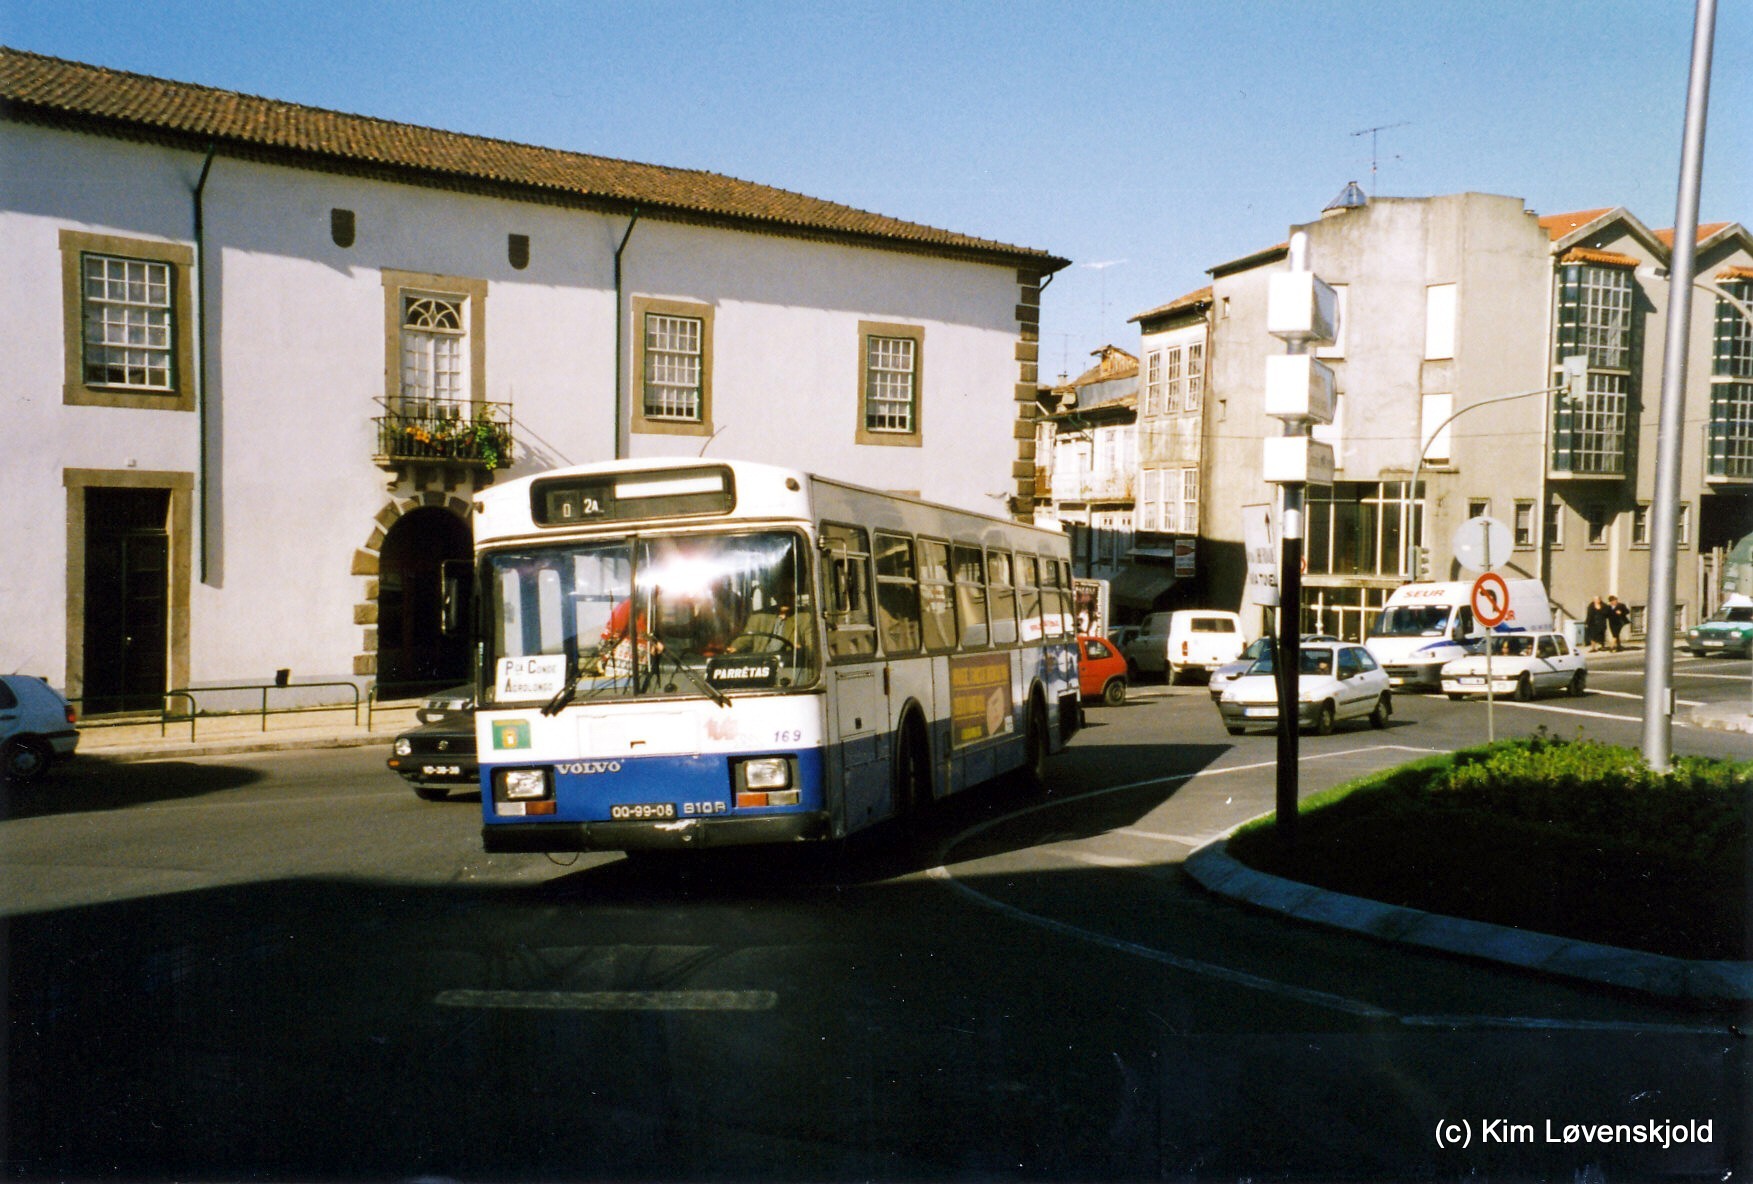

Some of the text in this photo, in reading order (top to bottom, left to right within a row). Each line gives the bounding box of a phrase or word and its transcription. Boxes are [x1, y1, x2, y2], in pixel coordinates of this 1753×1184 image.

[1404, 590, 1445, 598] SEUR
[774, 729, 803, 742] 169
[555, 761, 622, 774] VOLVO
